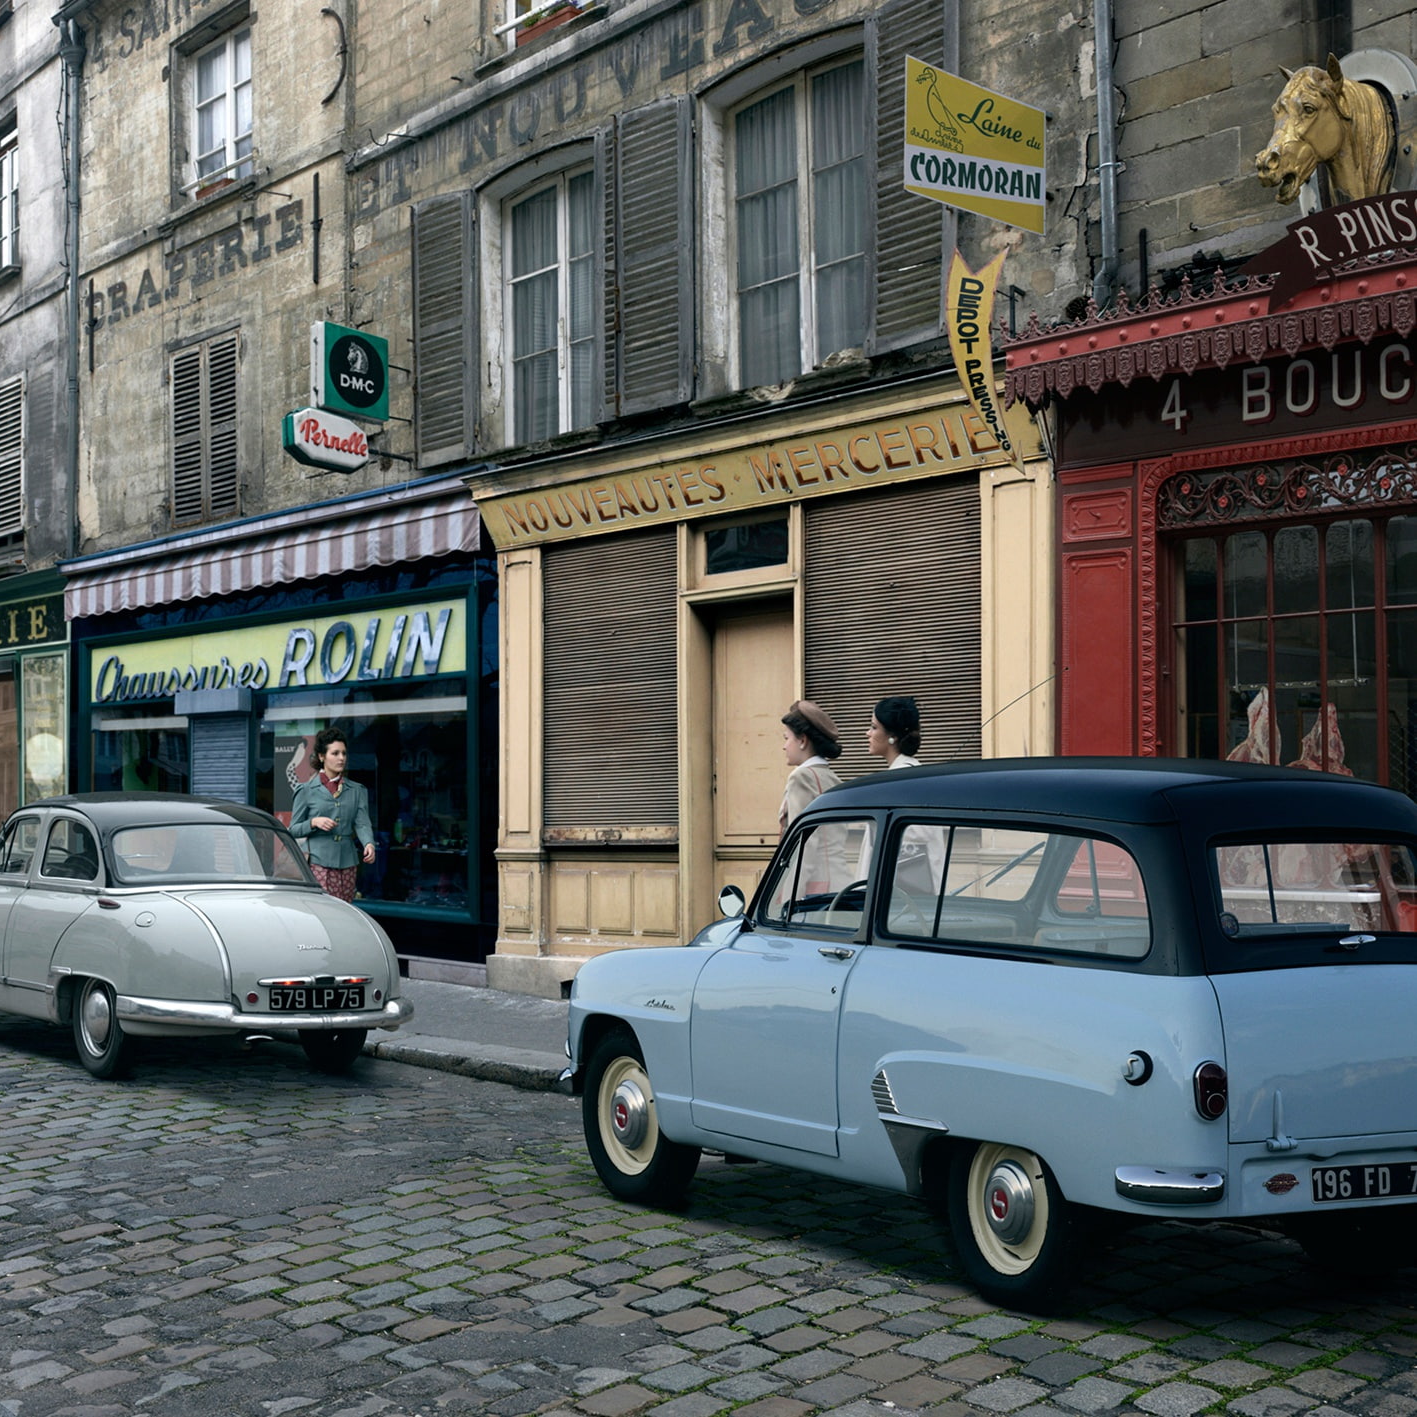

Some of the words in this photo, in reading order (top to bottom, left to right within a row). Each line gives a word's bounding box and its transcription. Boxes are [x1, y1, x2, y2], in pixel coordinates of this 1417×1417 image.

[459, 0, 836, 174] NOUVEA
[957, 98, 1023, 143] Laine
[1026, 136, 1041, 150] du
[910, 152, 1041, 199] CORMORAN
[1334, 198, 1417, 254] PINS
[84, 199, 304, 335] DRAPERIE
[956, 277, 984, 354] DEPOT
[965, 359, 1011, 451] PRESSING
[1161, 379, 1188, 430] 4
[1243, 344, 1413, 422] BOUC
[299, 417, 369, 457] Pernelle
[749, 410, 1001, 496] MERCERIE
[95, 655, 269, 703] Chaussures
[279, 608, 453, 688] ROLIN
[274, 745, 296, 753] BALLY
[270, 989, 306, 1009] 579
[312, 989, 334, 1008] LP
[338, 988, 360, 1008] 75
[1312, 1168, 1352, 1200] 196
[1364, 1166, 1391, 1196] FD
